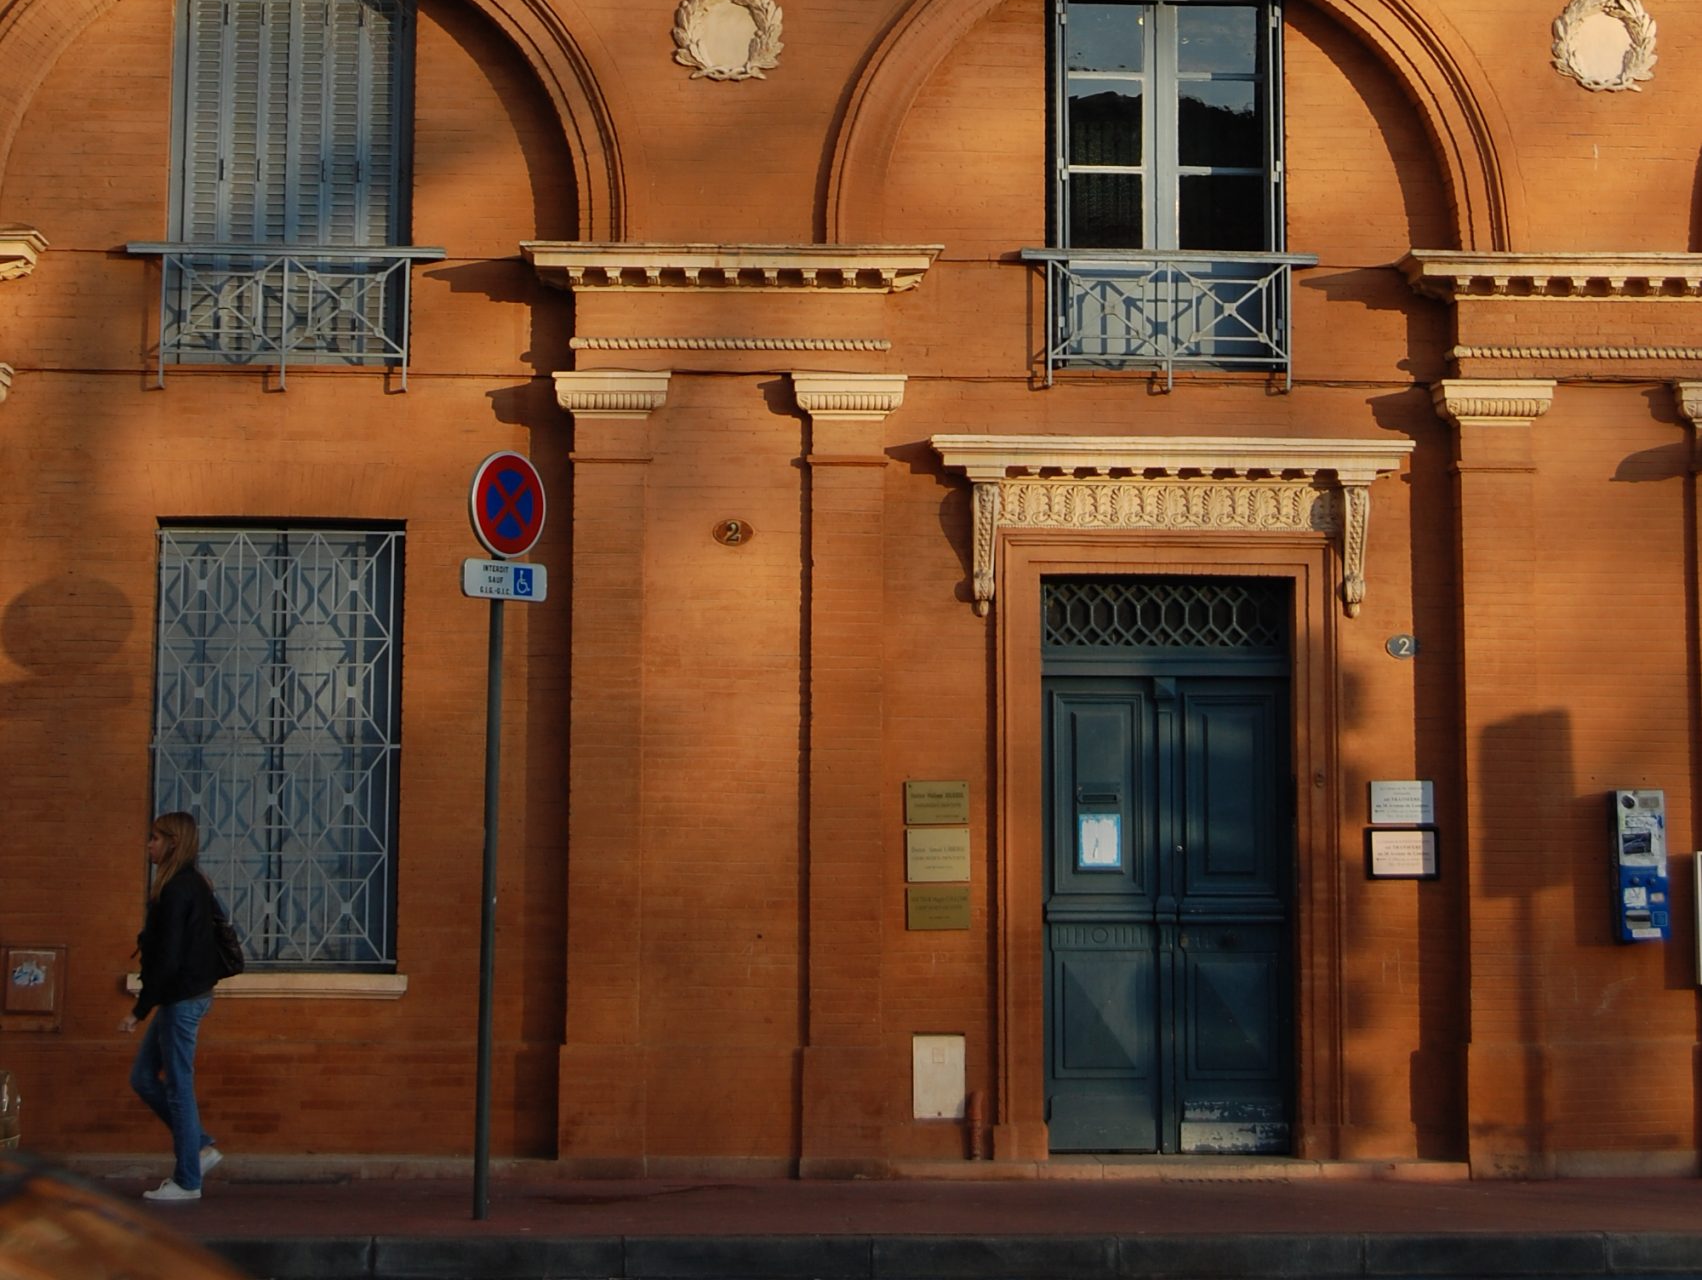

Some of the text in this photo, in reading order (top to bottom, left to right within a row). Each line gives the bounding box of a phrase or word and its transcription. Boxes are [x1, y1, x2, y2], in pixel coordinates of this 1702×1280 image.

[725, 520, 742, 544] 2
[482, 564, 510, 573] INTERDIT
[488, 576, 504, 584] SAUF
[1398, 638, 1411, 655] 2
